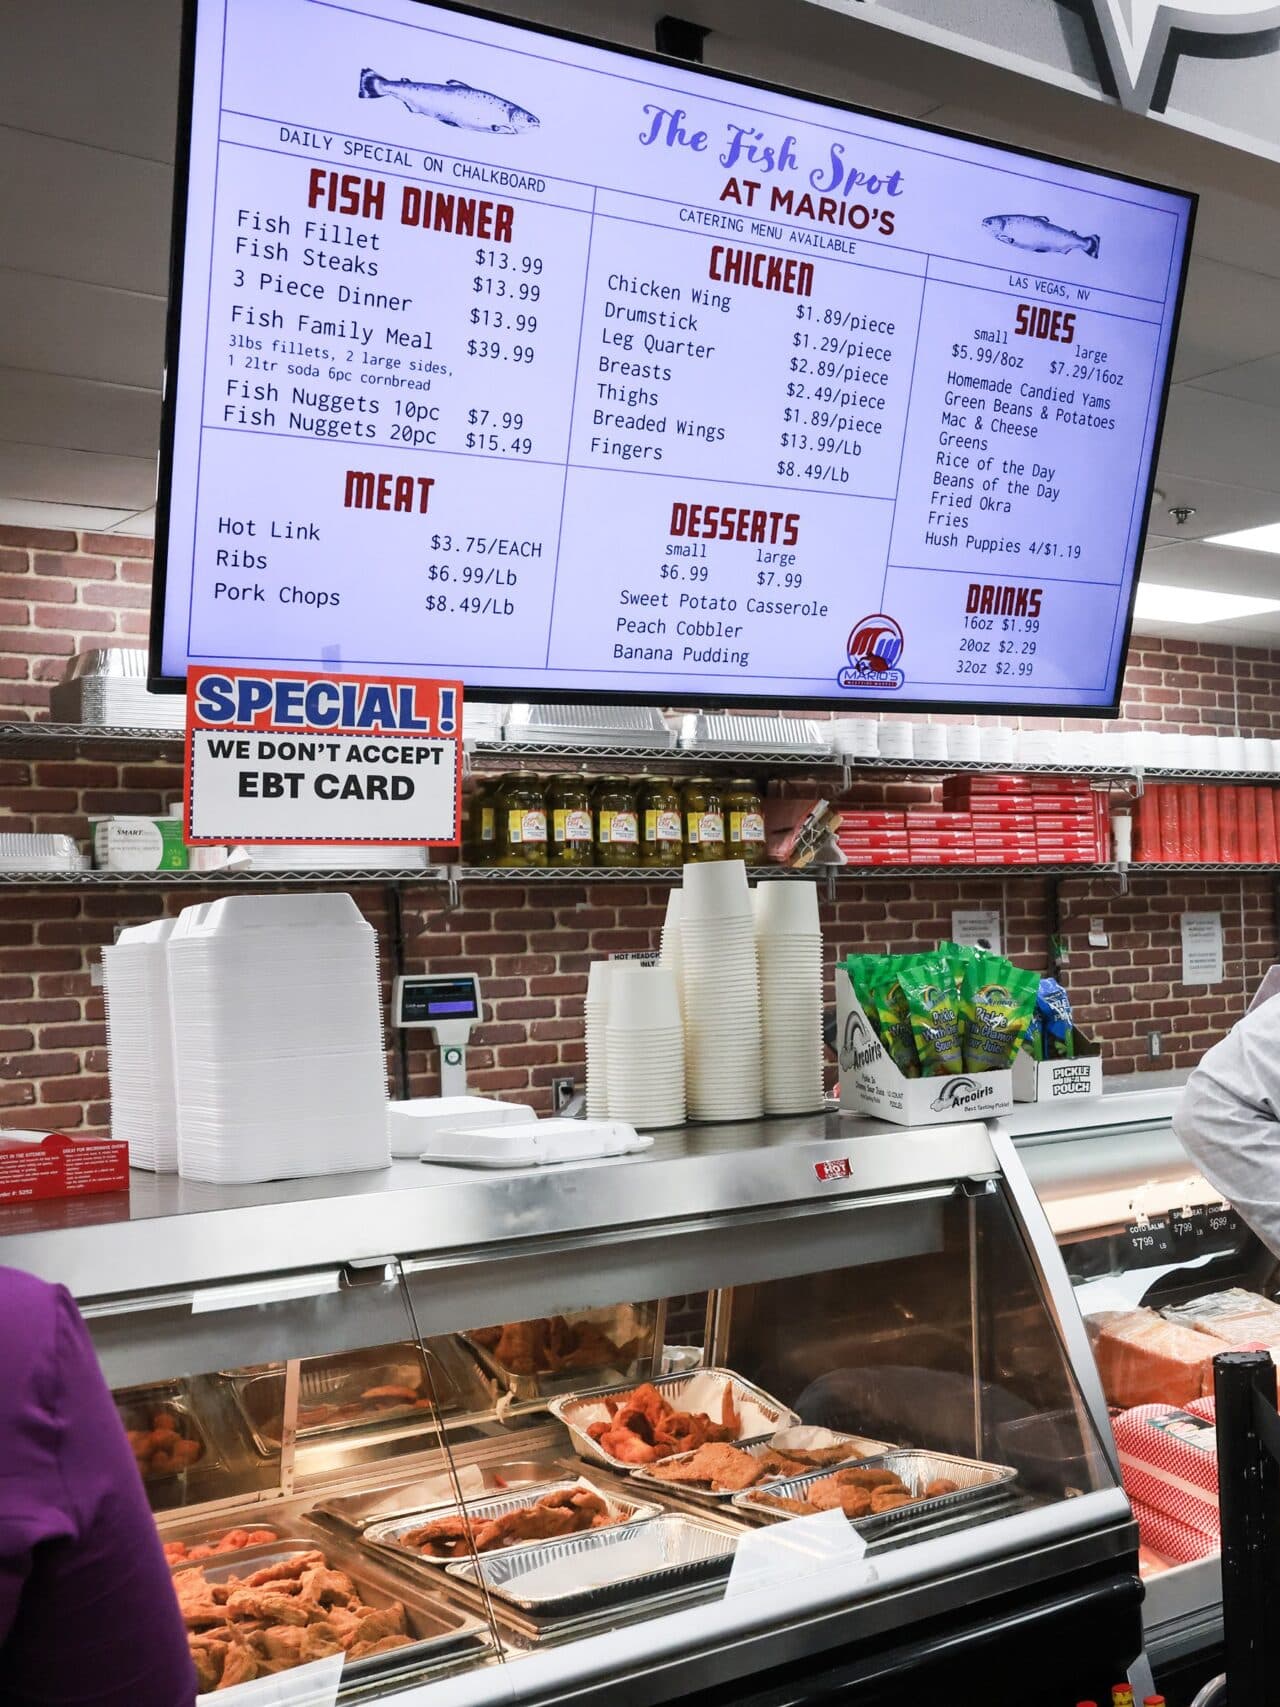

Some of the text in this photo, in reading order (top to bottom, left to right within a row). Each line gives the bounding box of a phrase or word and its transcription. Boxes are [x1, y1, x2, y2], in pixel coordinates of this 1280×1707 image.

[279, 126, 546, 193] DAILY SPECIAL ON CHALKBOARD
[638, 103, 905, 198] The Fish Spot
[307, 167, 515, 244] FISH DINNER
[718, 176, 896, 236] AT MARIO'S
[237, 209, 543, 276] Fish Fillet $13.99
[679, 207, 857, 255] CATERING MENU AVAILABLE
[235, 236, 541, 303] Fish Steaks $13.99
[708, 244, 815, 298] CHICKEN
[1008, 274, 1091, 301] LAS VEGAS, NV
[233, 268, 538, 334] 3 Piece Dinner $13.99
[607, 274, 896, 336] Chicken Wing $1.89/piece
[231, 304, 535, 364] Fish Family Meal $39.99
[604, 301, 893, 363] Drumstick $1.29/piece
[1013, 303, 1077, 345] SIDES
[272, 339, 335, 363] fillets,
[346, 349, 354, 363] 2
[361, 351, 402, 370] large
[408, 359, 453, 377] sides,
[602, 327, 889, 386] Leg Quarter $2.89/piece
[951, 343, 1124, 386] $5.99/8oz $7.29/16oz
[973, 329, 1108, 365] small large
[287, 363, 320, 378] soda
[328, 366, 353, 383] 6pc
[360, 373, 431, 392] cornbread
[598, 355, 886, 411] Breasts $2.49/piece
[947, 370, 1112, 410] Homemade Candied Yams
[227, 378, 524, 431] Fish Nuggets 10pc $7.99
[596, 382, 883, 435] Thighs $1.89/piece
[944, 390, 1116, 431] Green Beans & Potatoes
[224, 404, 533, 455] Fish Nuggets 20pc $15.49
[592, 408, 862, 457] Breaded Wings $13.99/Lb
[938, 430, 989, 452] Greens
[941, 410, 1039, 439] Mac & Cheese
[590, 437, 850, 484] Fingers $8.49/Lb
[936, 450, 1056, 483] Rice of the Day
[343, 469, 436, 515] MEAT
[930, 490, 1012, 513] Fried Okra
[932, 470, 1061, 503] Beans of the Day
[218, 516, 542, 559] Hot Link $3.75/EACH
[669, 502, 801, 547] DESSERTS
[928, 510, 969, 529] Fries
[664, 542, 796, 568] small large
[924, 530, 1081, 560] Hush Puppies 4/$1.19
[216, 549, 517, 587] Ribs $6.99/Lb
[659, 563, 803, 589] $6.99 $7.99
[214, 582, 515, 616] Pork Chops $8.49/Lb
[619, 589, 829, 617] Sweet Potato Casserole
[964, 583, 1044, 619] DRINKS
[616, 616, 744, 639] Peach Cobbler
[964, 615, 1040, 634] 16oz $1.99
[613, 643, 750, 668] Banana Pudding
[959, 637, 1037, 656] 20oz $2.29
[844, 670, 898, 681] MARIO'S
[955, 659, 1034, 677] 32oz $2.99
[207, 739, 444, 766] WE DON'T ACCEPT
[238, 771, 415, 801] EBT CARD
[1052, 1065, 1091, 1080] PICKLE
[1052, 1081, 1091, 1096] POUCH
[951, 1086, 994, 1108] Arcoiris
